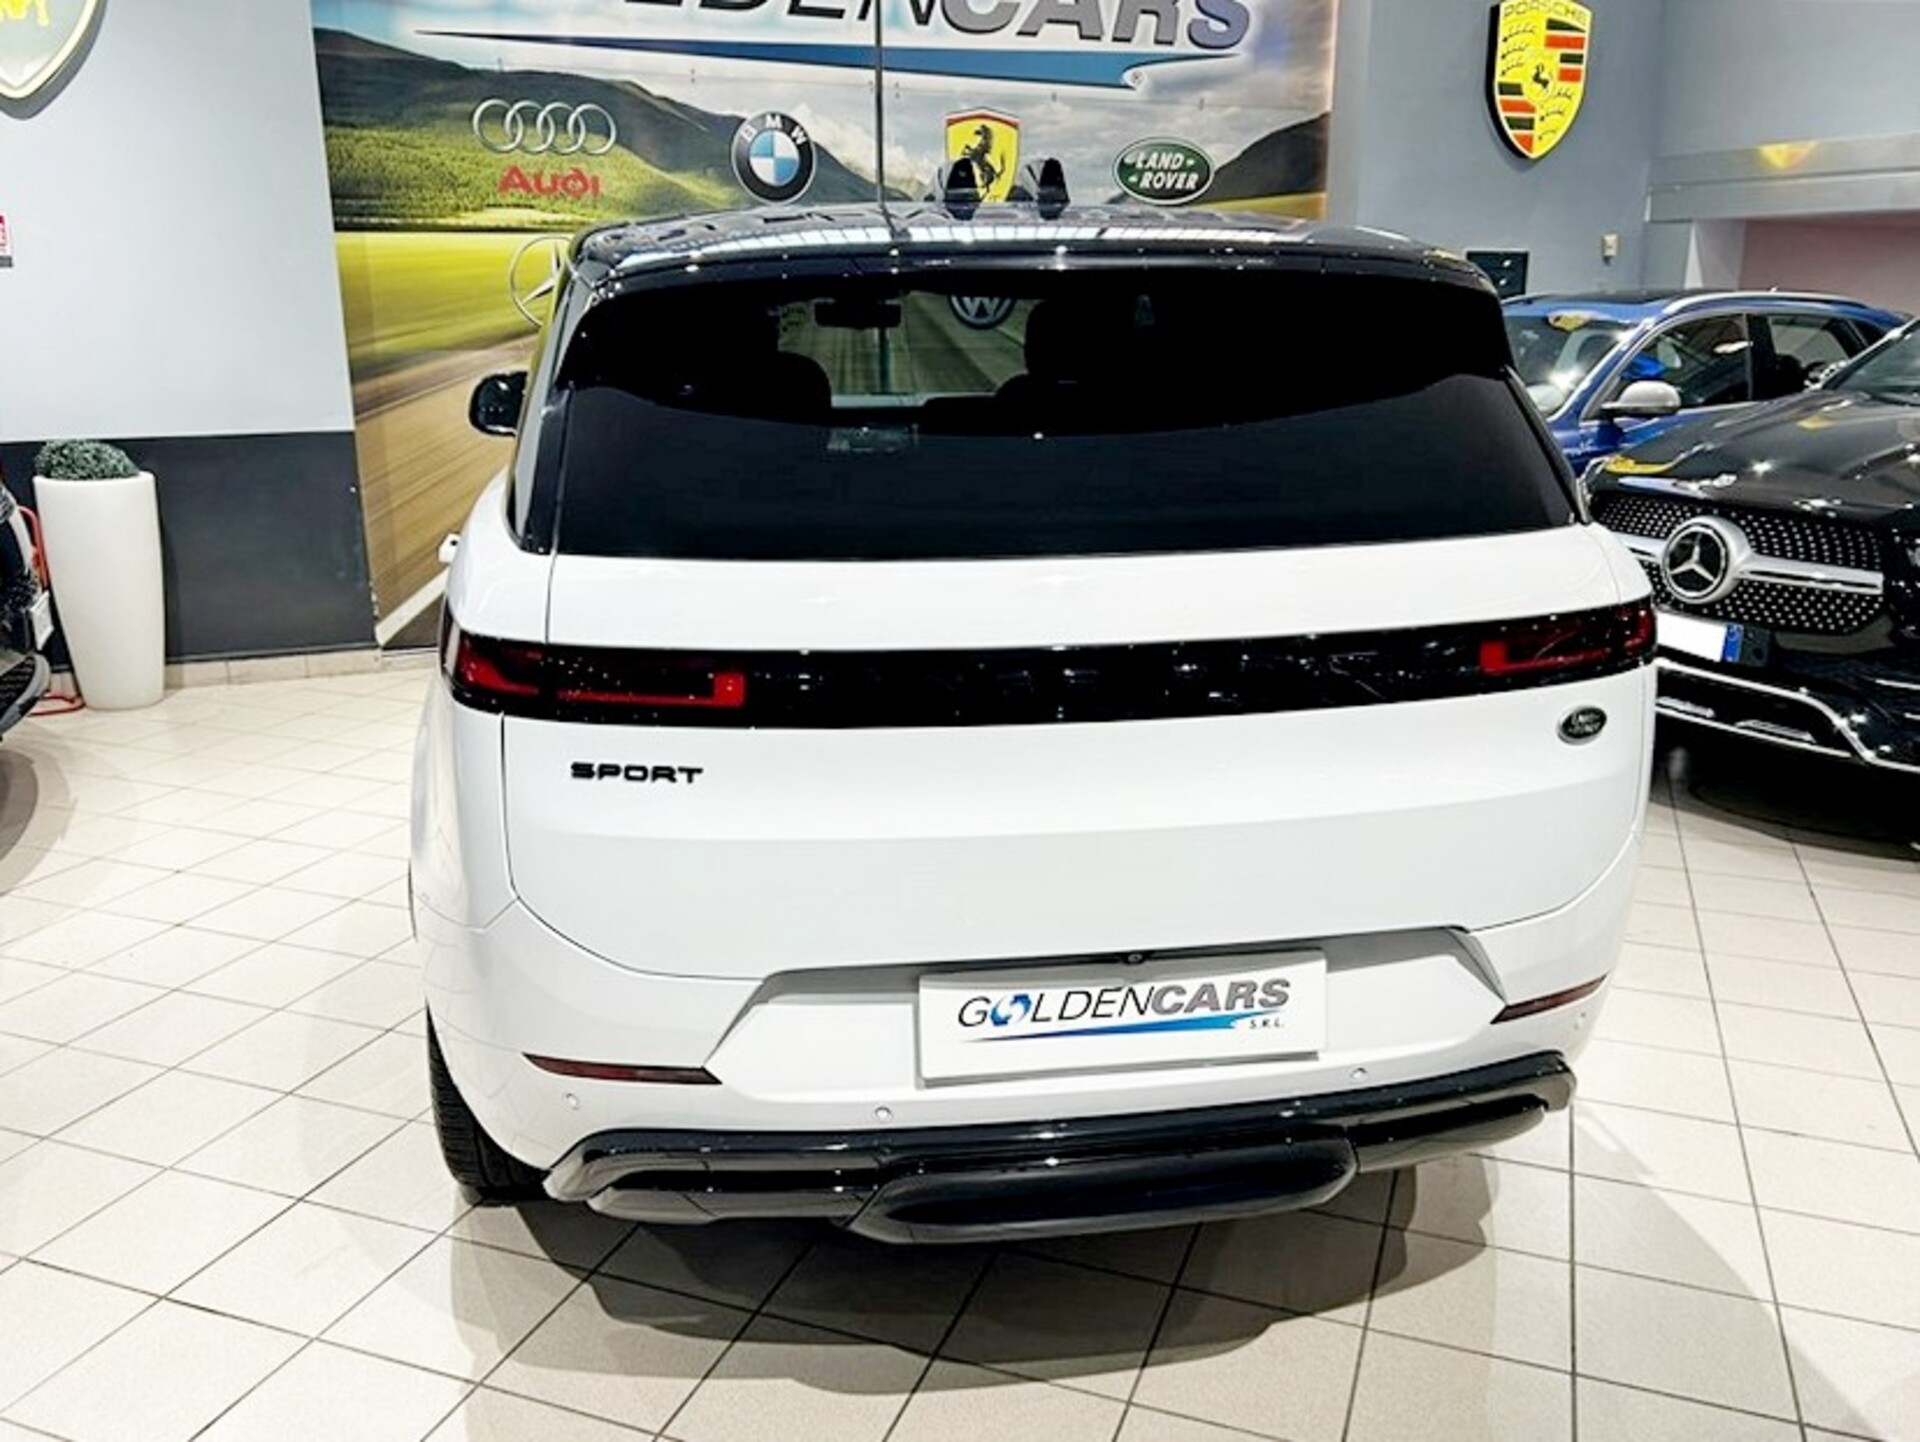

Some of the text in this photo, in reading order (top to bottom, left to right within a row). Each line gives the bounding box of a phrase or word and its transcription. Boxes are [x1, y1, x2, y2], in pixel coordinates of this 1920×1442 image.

[740, 114, 807, 145] BMW
[1135, 151, 1184, 170] LAND
[500, 166, 601, 199] Audi
[1139, 171, 1199, 190] ROVER
[570, 761, 704, 784] SPORT
